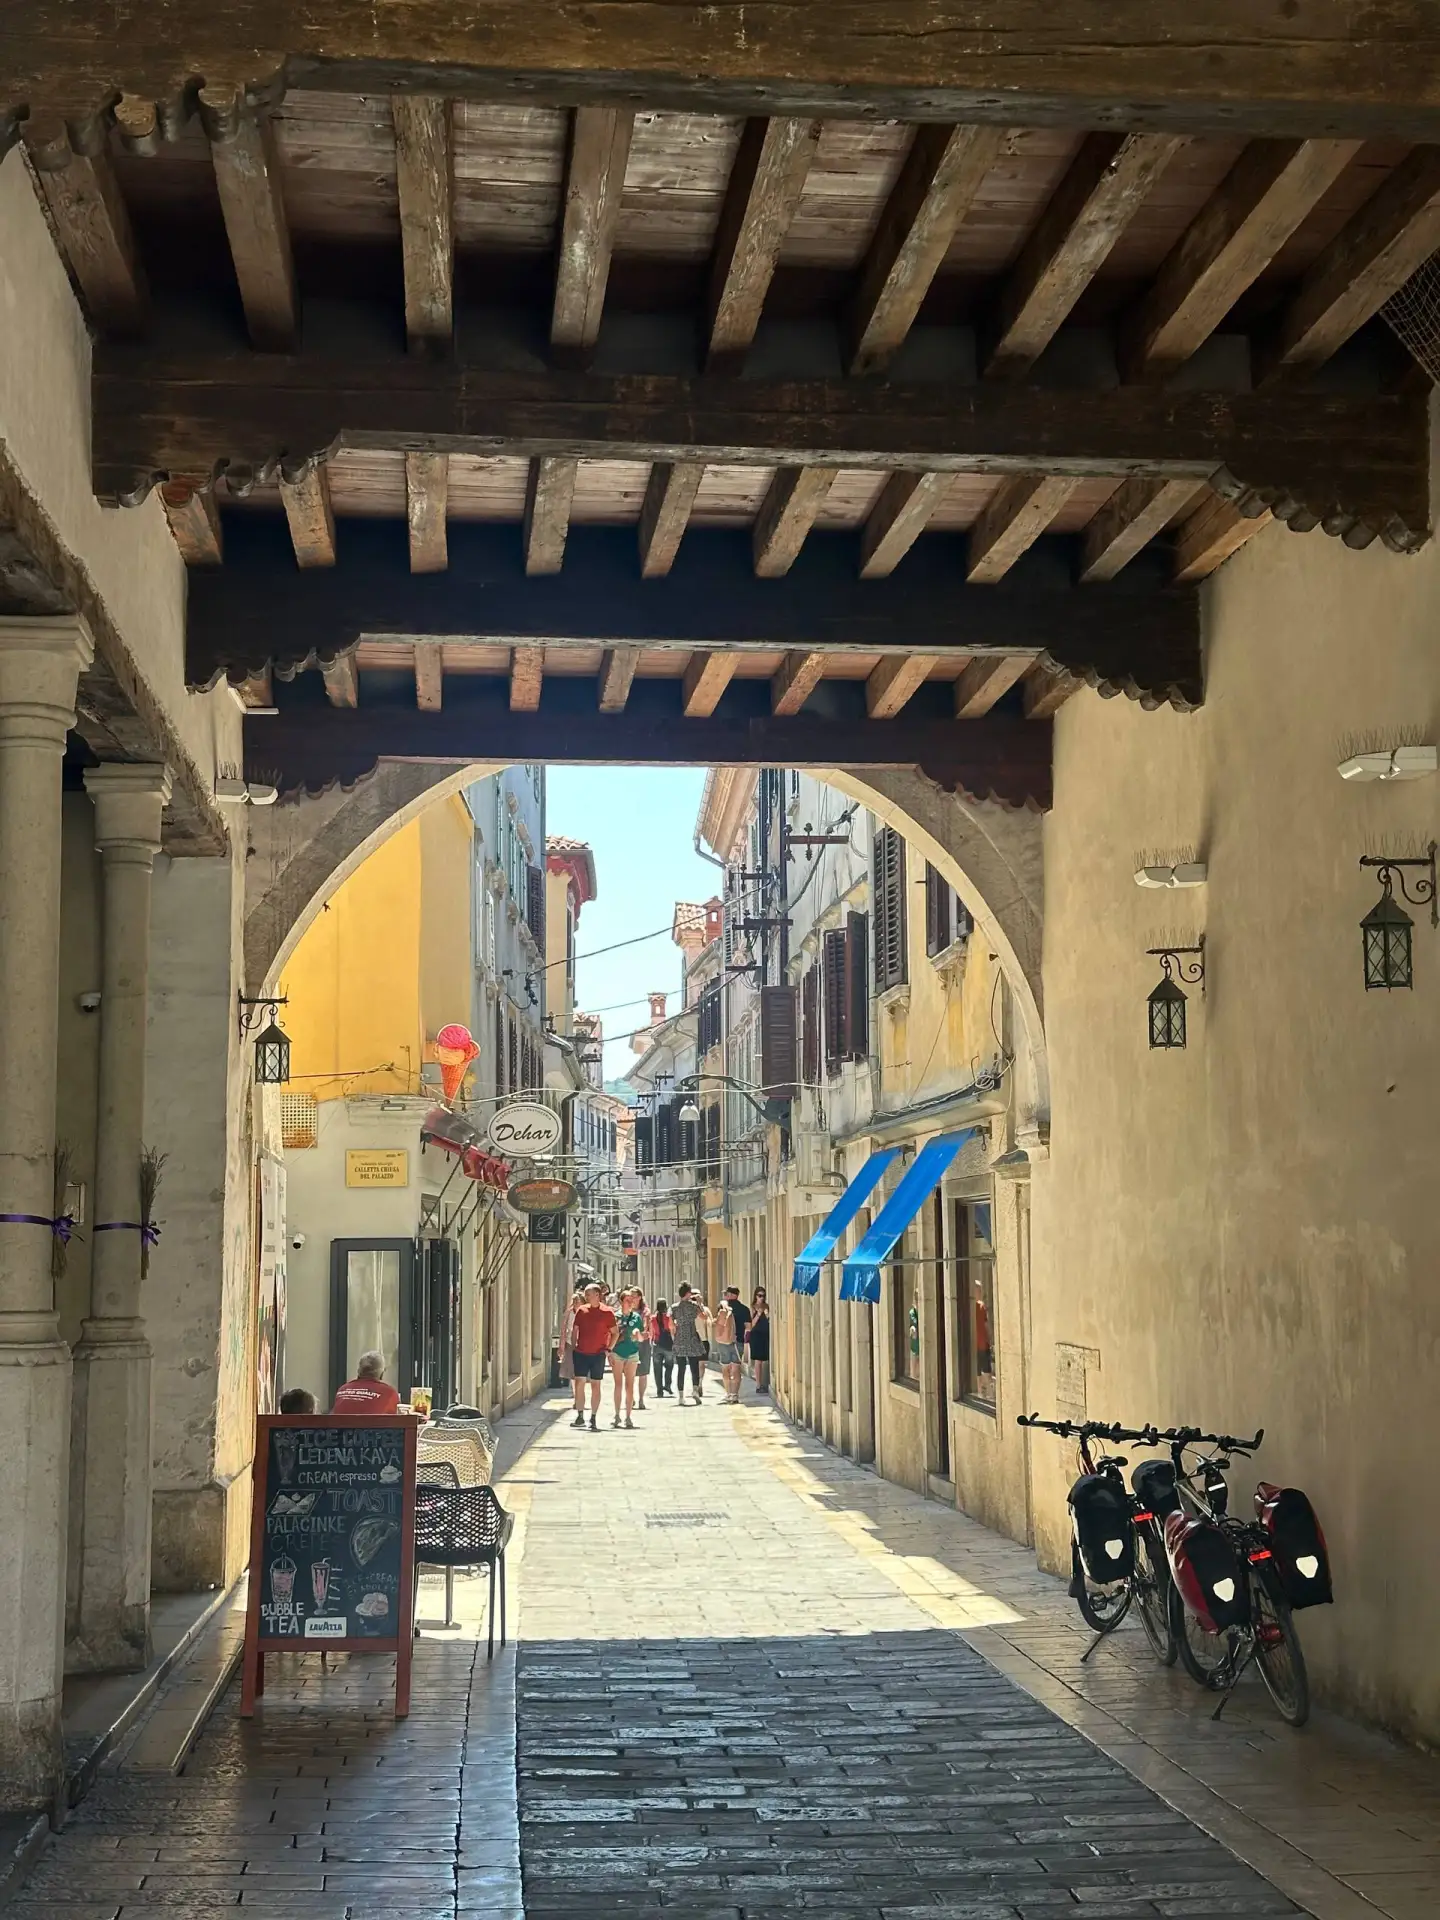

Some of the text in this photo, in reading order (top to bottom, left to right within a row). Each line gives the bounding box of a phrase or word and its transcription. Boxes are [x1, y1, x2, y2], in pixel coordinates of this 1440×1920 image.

[495, 1123, 553, 1142] Dehar
[299, 1428, 339, 1448] ICE
[298, 1447, 358, 1467] LEDENA
[298, 1471, 377, 1486] CREAM espresso
[326, 1487, 402, 1515] TOAST
[261, 1601, 305, 1617] BUBBLE
[265, 1615, 300, 1635] TEA
[309, 1621, 343, 1632] LAVAZZA
